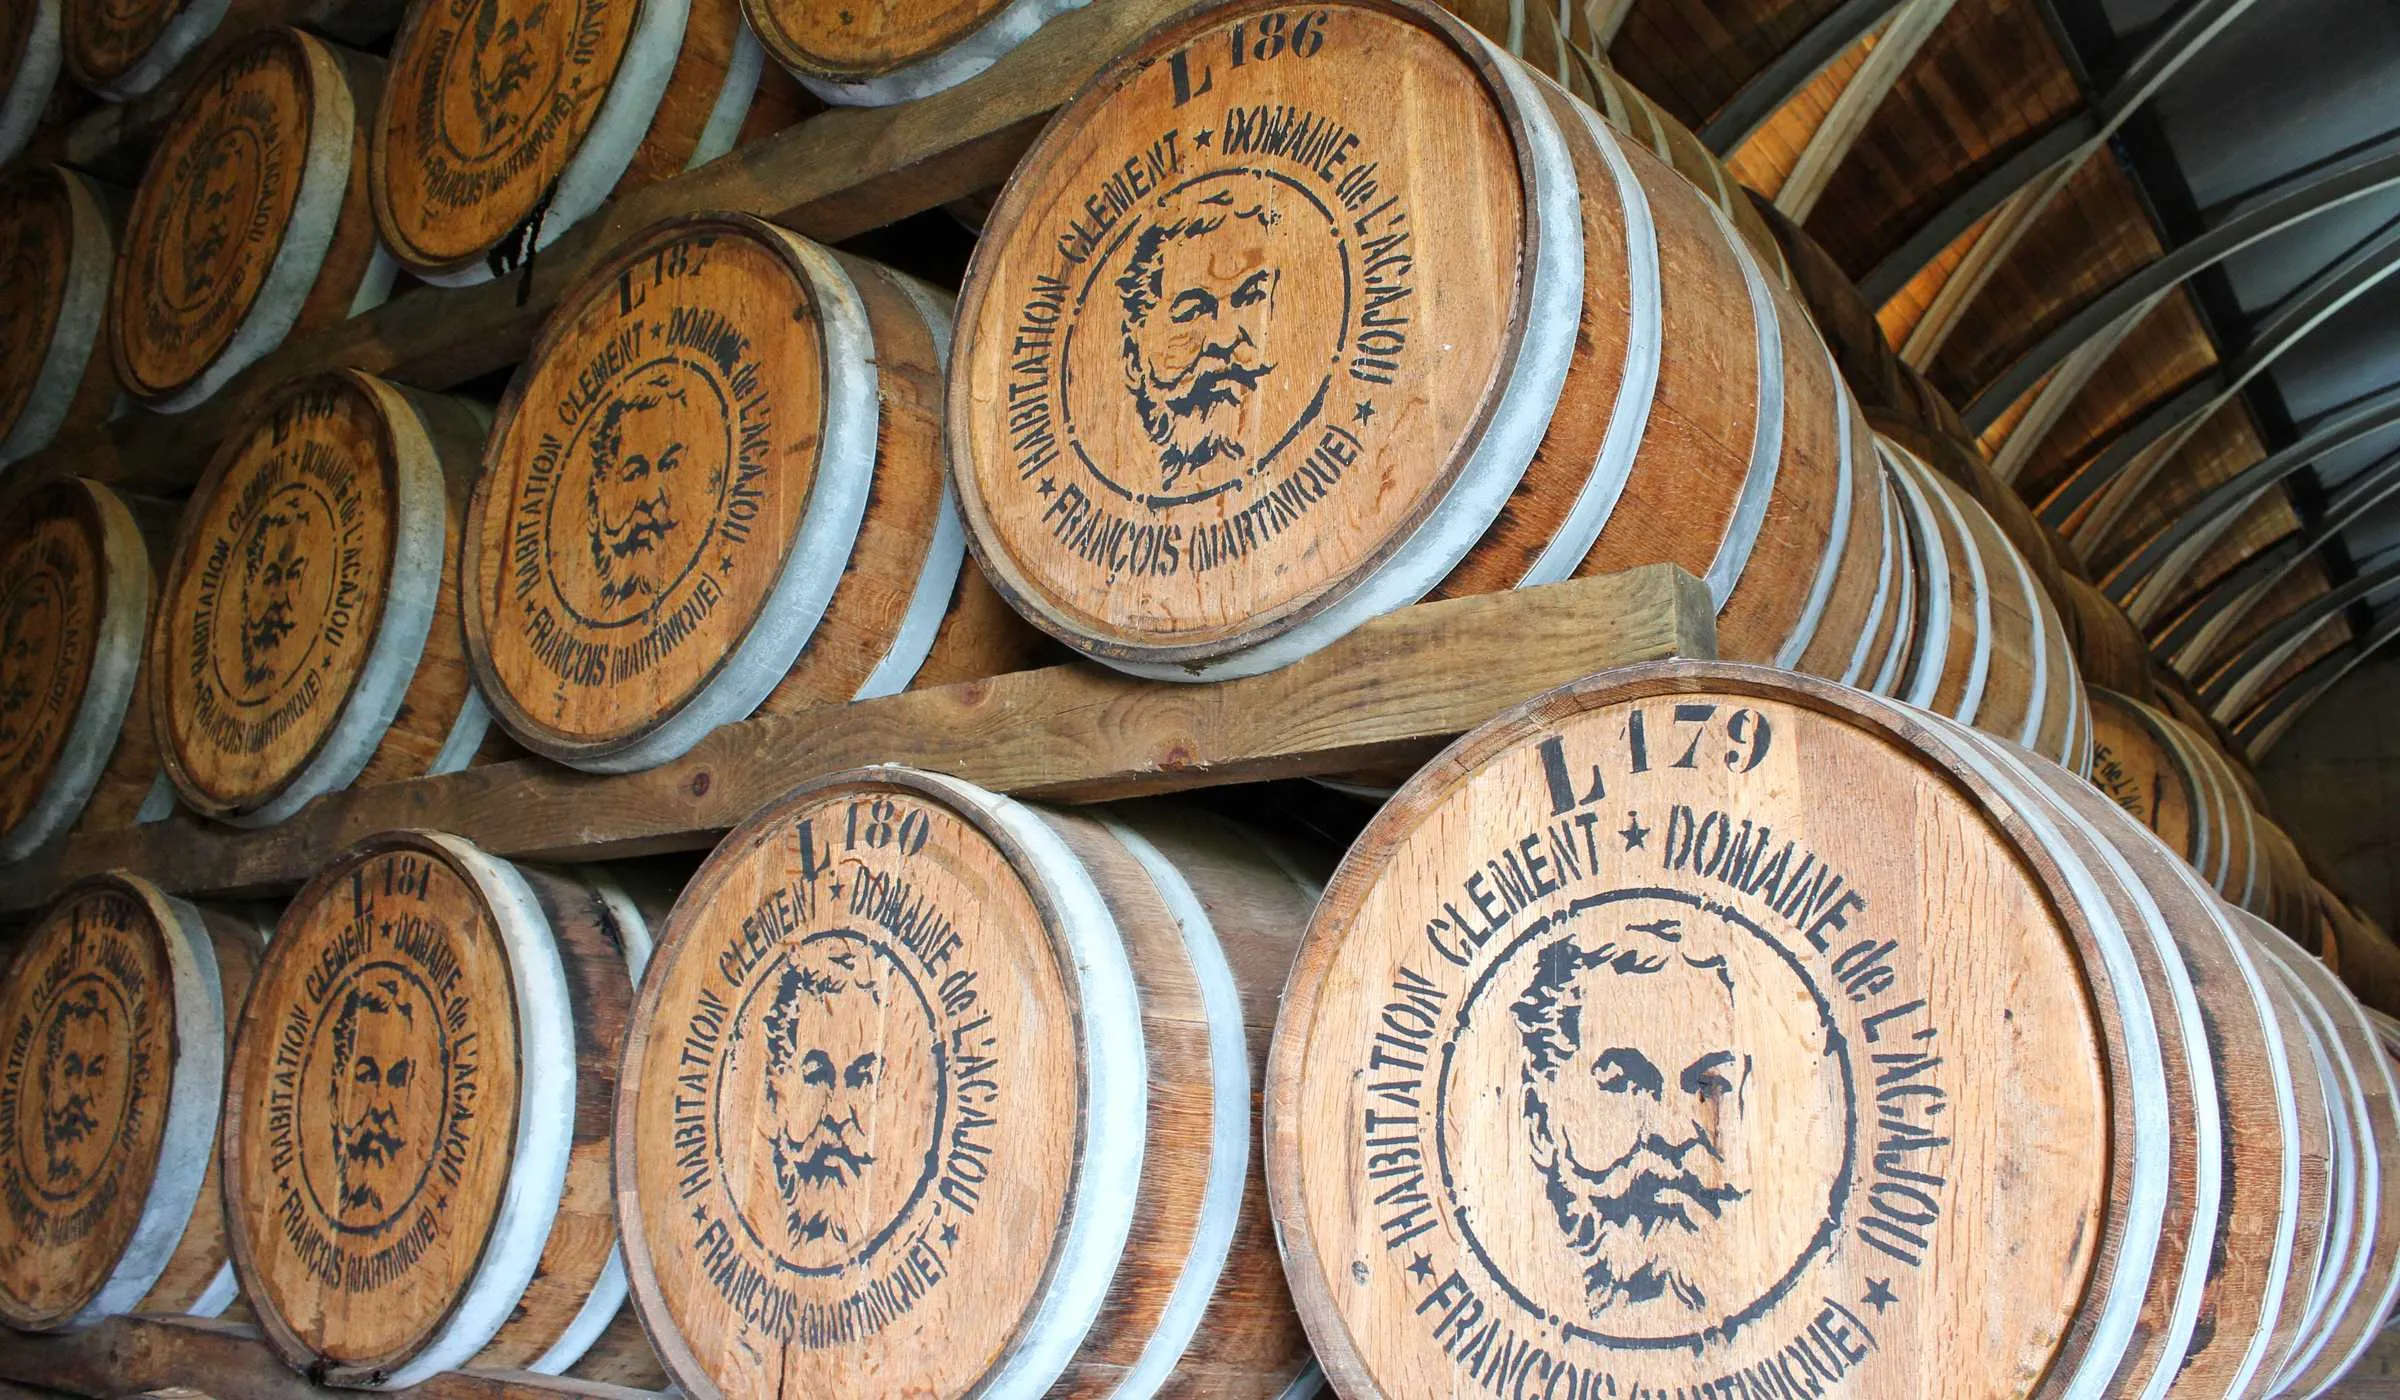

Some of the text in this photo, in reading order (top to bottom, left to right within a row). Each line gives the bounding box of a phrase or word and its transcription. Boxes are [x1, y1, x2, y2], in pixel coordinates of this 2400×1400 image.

[1008, 105, 1413, 480] HABITATION CLEMENT DOMAINE de L'ACAJOU
[516, 434, 560, 599] HABITATION
[558, 320, 643, 426] CLEMENT
[1041, 424, 1367, 584] FRANÇOIS (MARTINIQUE)
[270, 1003, 310, 1177] HABITATION
[306, 914, 373, 1004] CLEMENT
[394, 911, 462, 1001] DOMAINE
[675, 866, 999, 1215] HABITATION CLEMENT DOMAINE de L'ACAJOU
[1366, 803, 1950, 1267] HABITATION CLEMENT DOMAINE de L'ACAJOU
